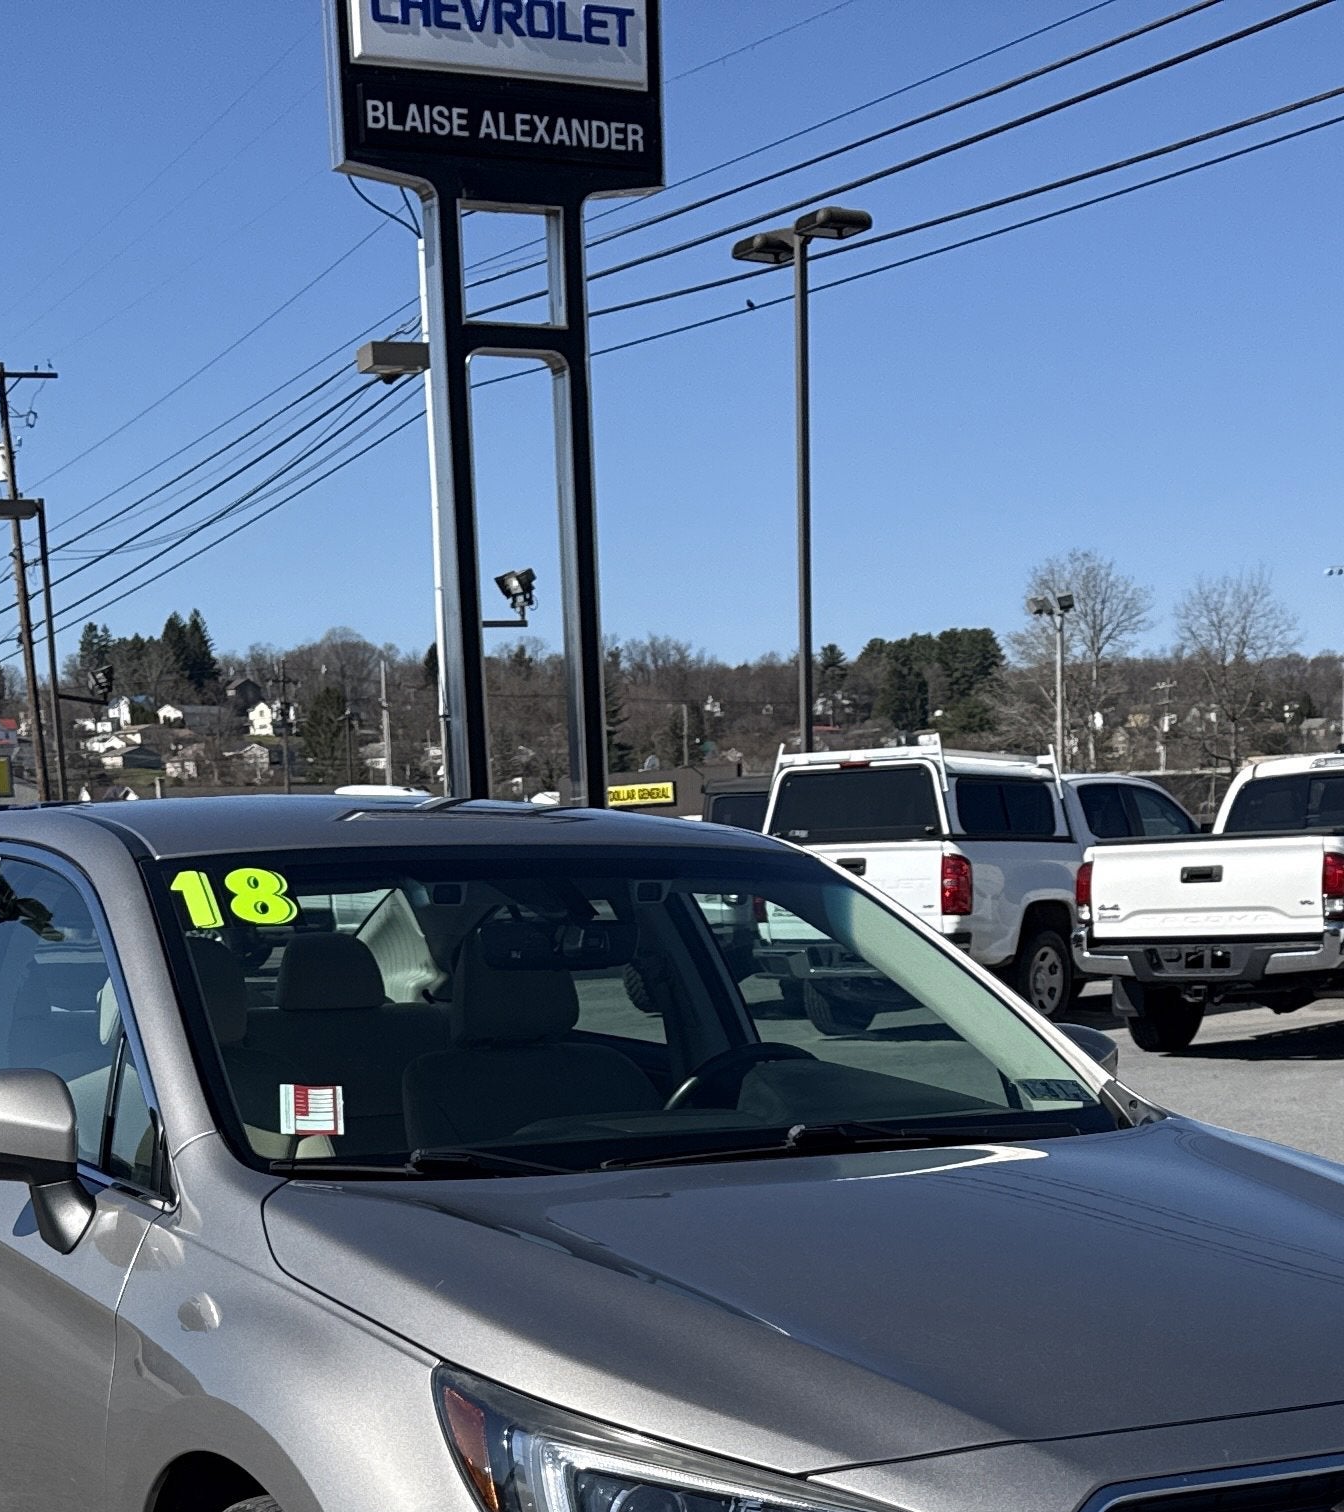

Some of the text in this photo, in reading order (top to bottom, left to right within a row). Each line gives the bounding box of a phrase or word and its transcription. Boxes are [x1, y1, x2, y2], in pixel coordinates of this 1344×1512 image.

[371, 0, 635, 47] CHEVROLET
[366, 99, 645, 152] BLAISE ALEXANDER
[170, 867, 298, 928] 18
